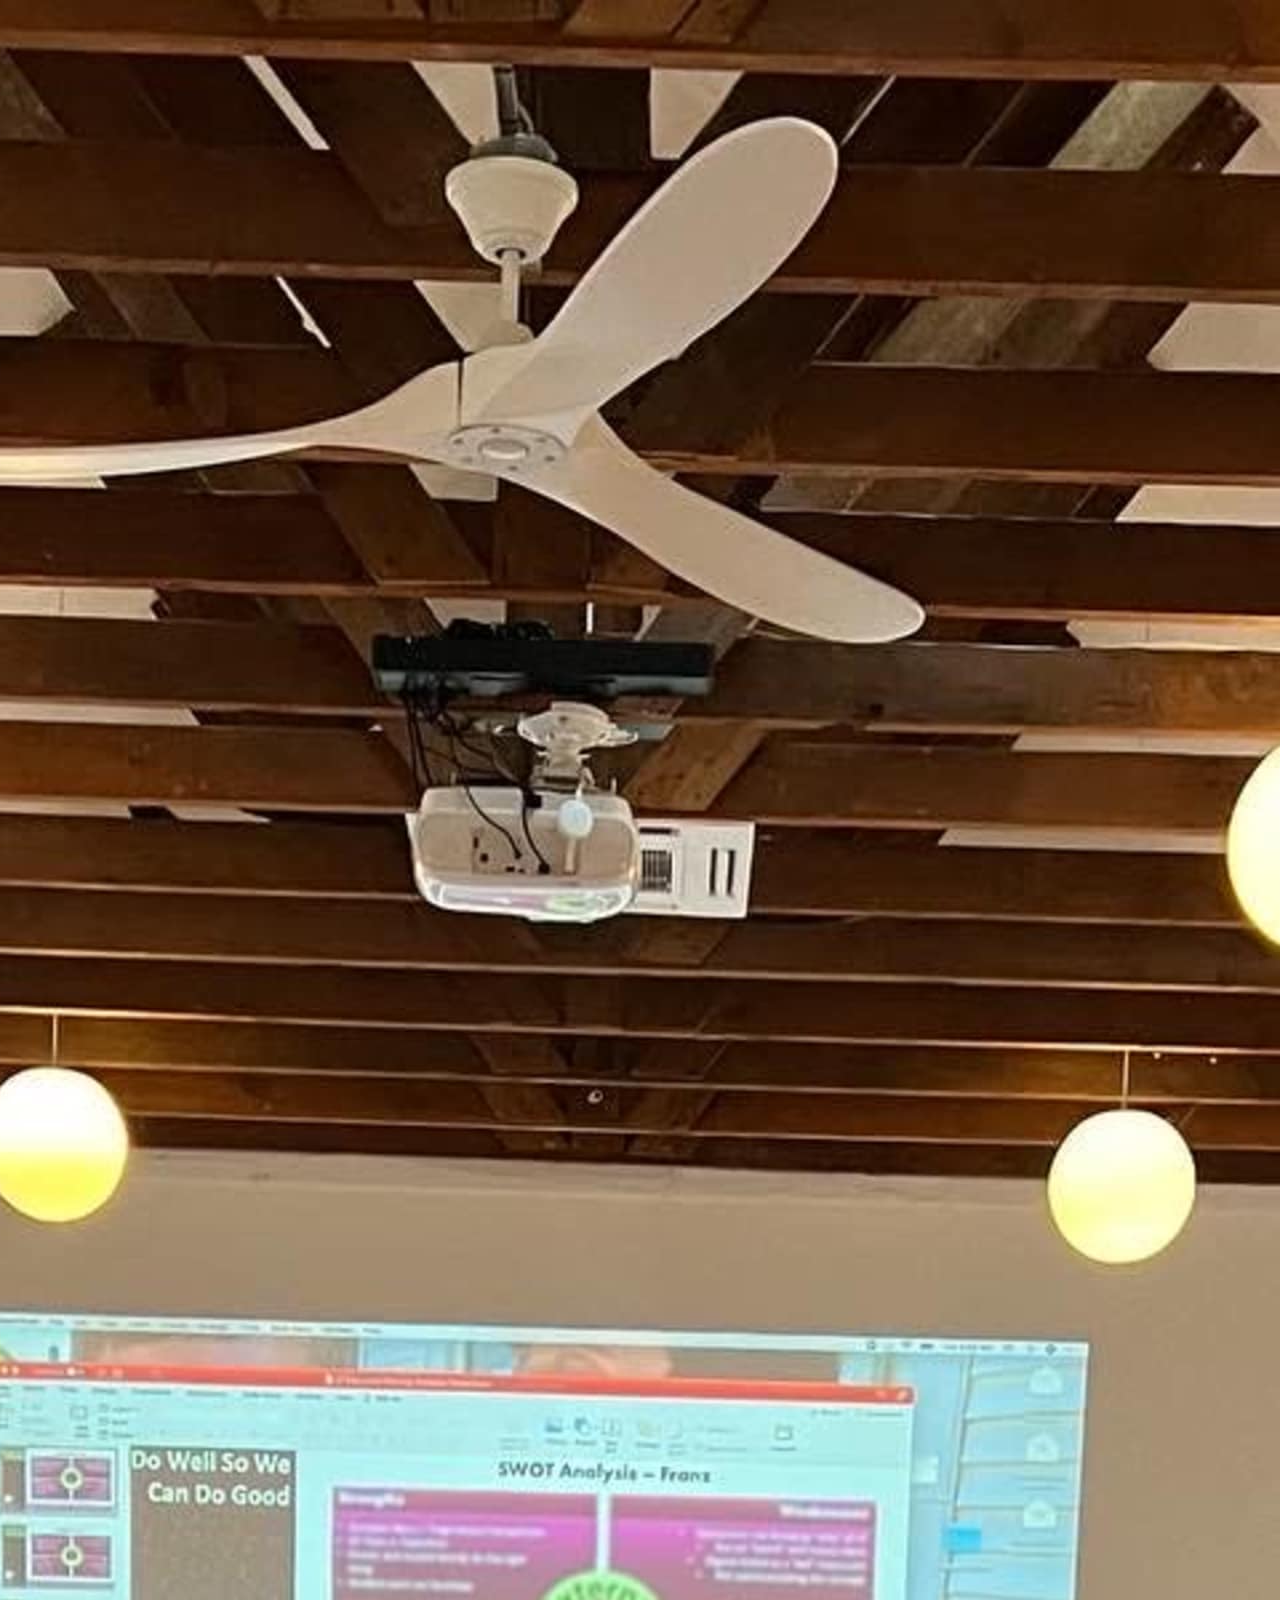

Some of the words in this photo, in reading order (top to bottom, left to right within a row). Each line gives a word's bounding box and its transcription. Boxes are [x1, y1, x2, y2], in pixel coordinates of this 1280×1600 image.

[132, 1450, 161, 1471] Do
[167, 1450, 217, 1472] Well
[221, 1452, 249, 1473] So
[254, 1452, 291, 1474] We
[498, 1461, 555, 1478] SWOT
[559, 1462, 637, 1484] Analysis
[148, 1482, 189, 1504] Can
[195, 1484, 226, 1505] Do
[231, 1484, 290, 1506] Good
